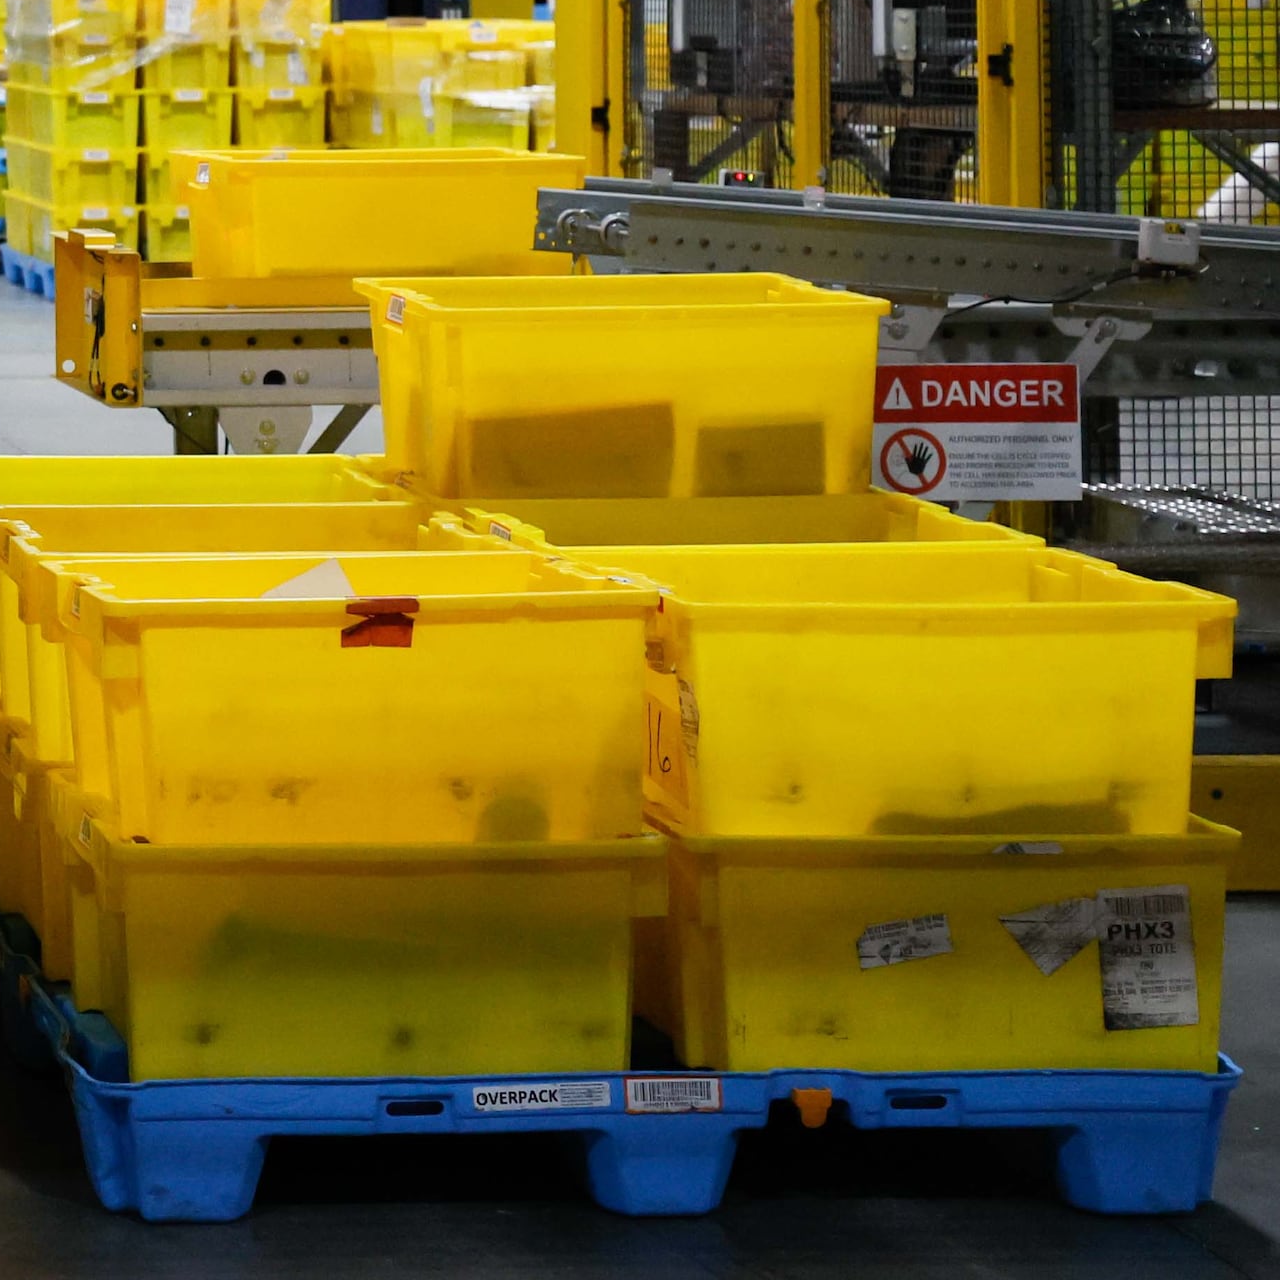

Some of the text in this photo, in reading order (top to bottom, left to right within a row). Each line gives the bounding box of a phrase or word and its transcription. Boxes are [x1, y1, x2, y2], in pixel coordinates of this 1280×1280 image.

[922, 380, 1065, 407] DANGER
[948, 435, 1074, 443] AUTHORIZED PERSONNEL ONLY
[648, 702, 672, 776] 16
[1108, 921, 1175, 940] PHX3
[1150, 943, 1176, 954] TOTE
[476, 1089, 558, 1106] OVERPACK
